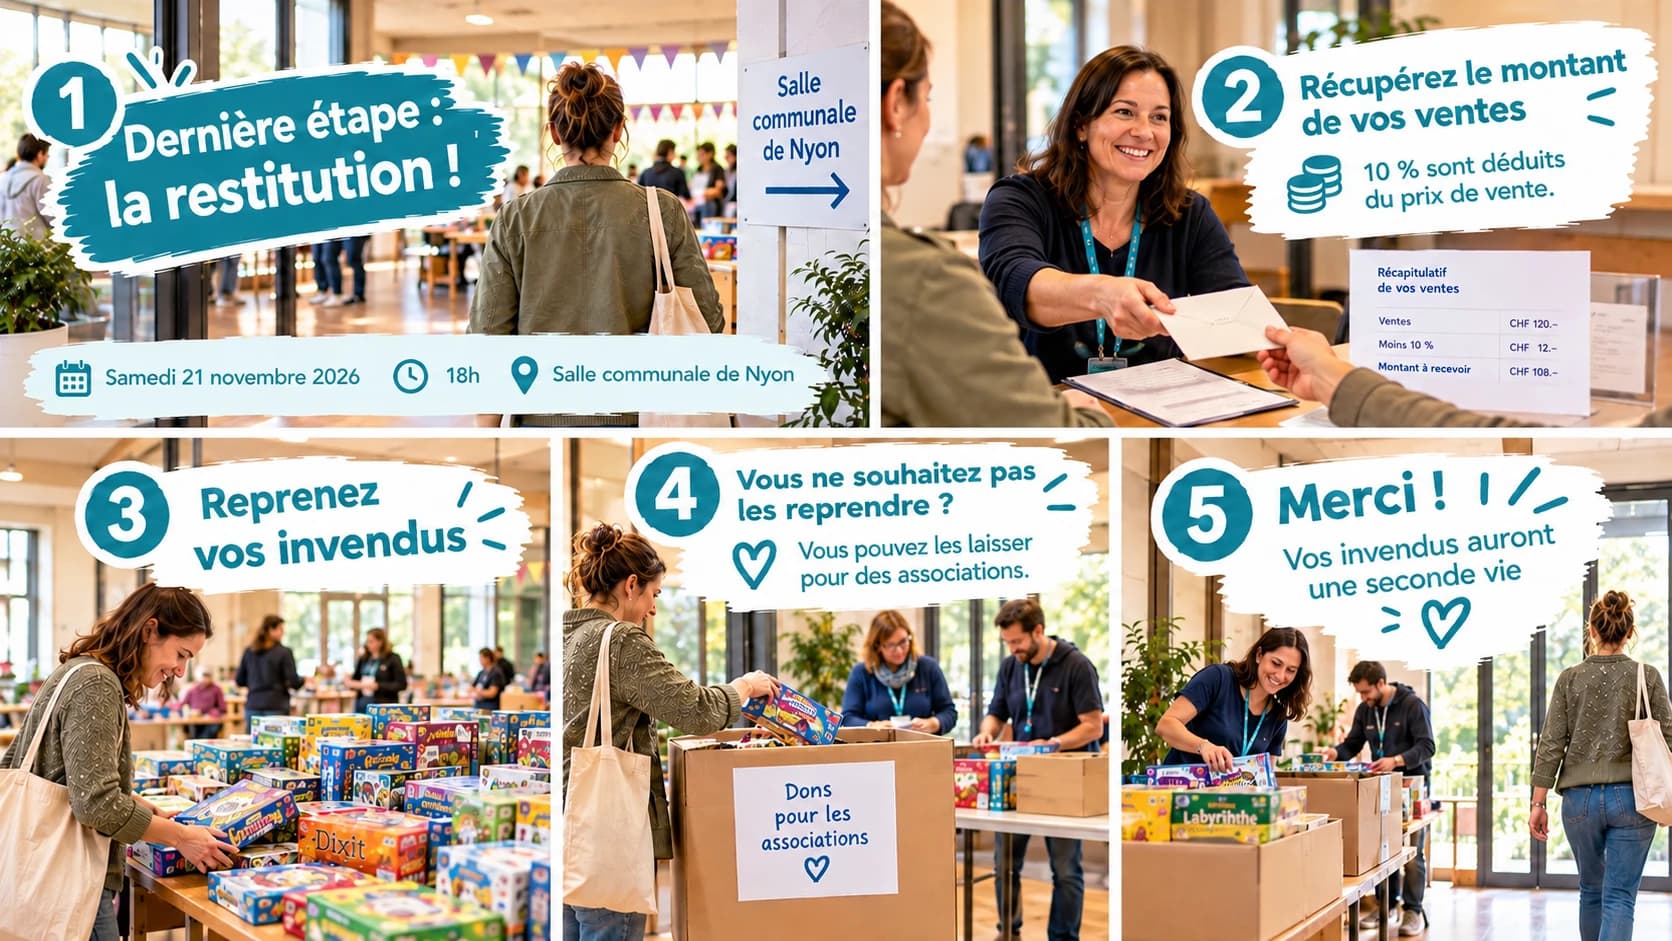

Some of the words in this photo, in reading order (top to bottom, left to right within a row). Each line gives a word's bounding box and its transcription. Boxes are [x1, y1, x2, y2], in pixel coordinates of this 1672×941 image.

[778, 71, 821, 97] Salle
[753, 99, 856, 130] communale
[764, 139, 784, 160] de
[791, 138, 839, 165] Nyon
[1378, 267, 1447, 280] Récapitulatif
[1378, 282, 1392, 292] de
[1396, 285, 1415, 293] vos
[1420, 284, 1459, 293] ventes
[1379, 317, 1411, 325] Ventes
[1510, 319, 1529, 328] CHF
[1379, 340, 1407, 349] Moins
[1411, 341, 1421, 349] 10
[1425, 341, 1433, 349] %
[1510, 343, 1529, 352] CHF
[1379, 362, 1419, 372] Montant
[1422, 363, 1428, 372] à
[1431, 365, 1471, 373] recevoir
[1510, 367, 1529, 376] CHF
[785, 783, 831, 800] Dons
[776, 811, 818, 830] pour
[827, 804, 850, 822] les
[315, 829, 366, 860] Dixit
[762, 831, 868, 850] associations
